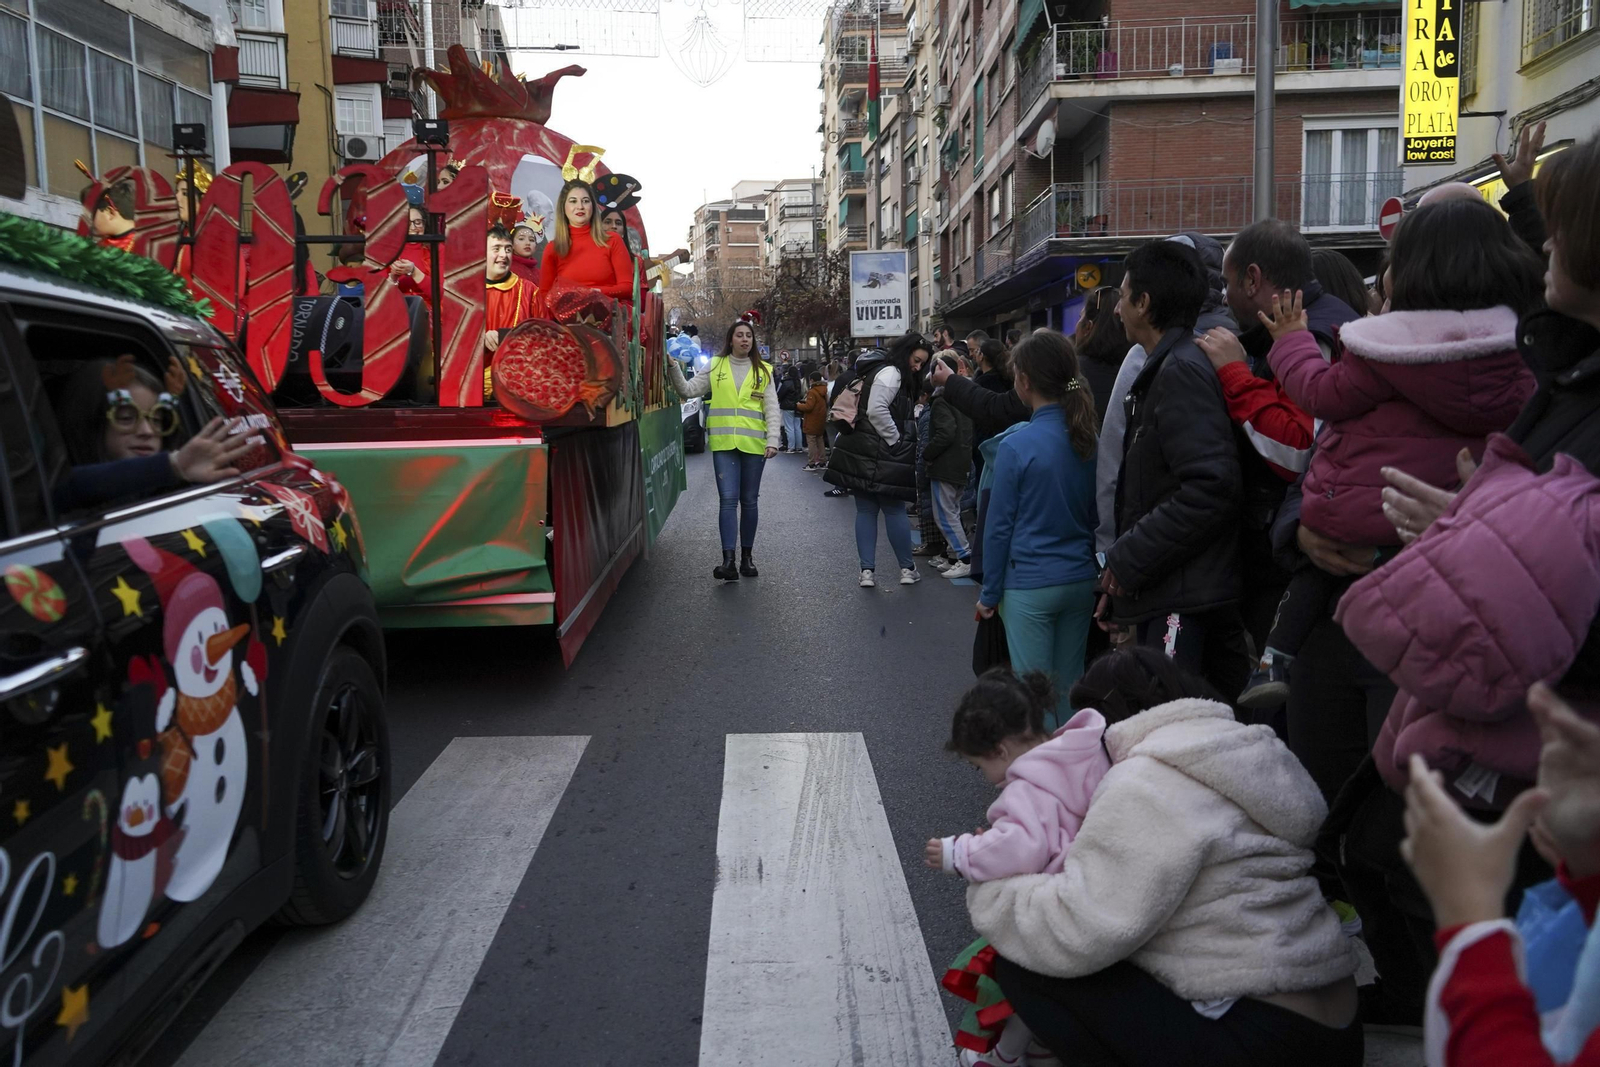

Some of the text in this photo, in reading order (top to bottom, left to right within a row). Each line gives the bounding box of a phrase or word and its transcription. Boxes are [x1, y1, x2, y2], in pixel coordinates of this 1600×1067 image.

[1435, 49, 1455, 68] de
[1409, 80, 1454, 107] ORO y
[1406, 112, 1455, 134] PLATA
[1407, 149, 1455, 161] low cost
